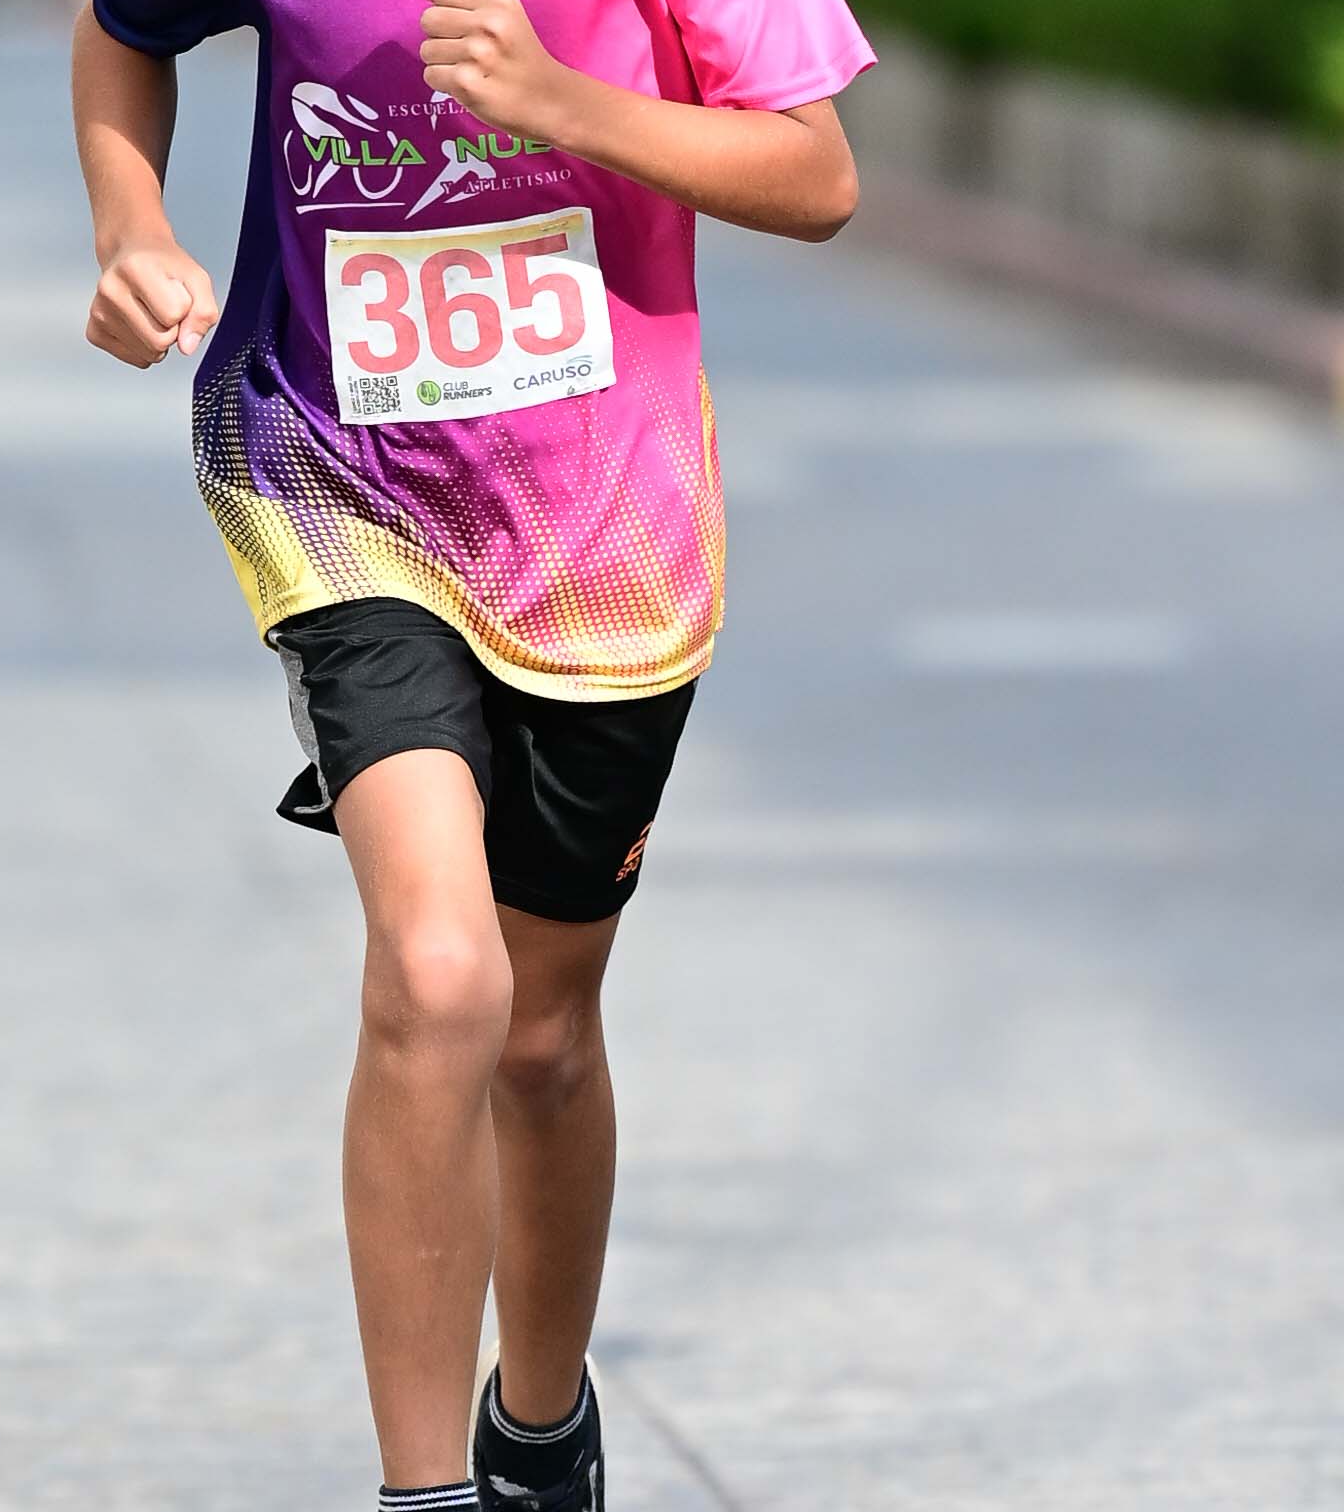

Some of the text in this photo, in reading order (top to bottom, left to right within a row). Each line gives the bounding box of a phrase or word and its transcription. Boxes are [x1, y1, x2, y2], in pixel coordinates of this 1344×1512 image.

[302, 134, 427, 165] VILLA
[442, 168, 572, 194] Y ATLETISMO
[341, 232, 586, 375] 365
[443, 381, 469, 392] CLUB
[513, 363, 592, 390] CARUSO
[443, 386, 493, 400] RUNNER'S
